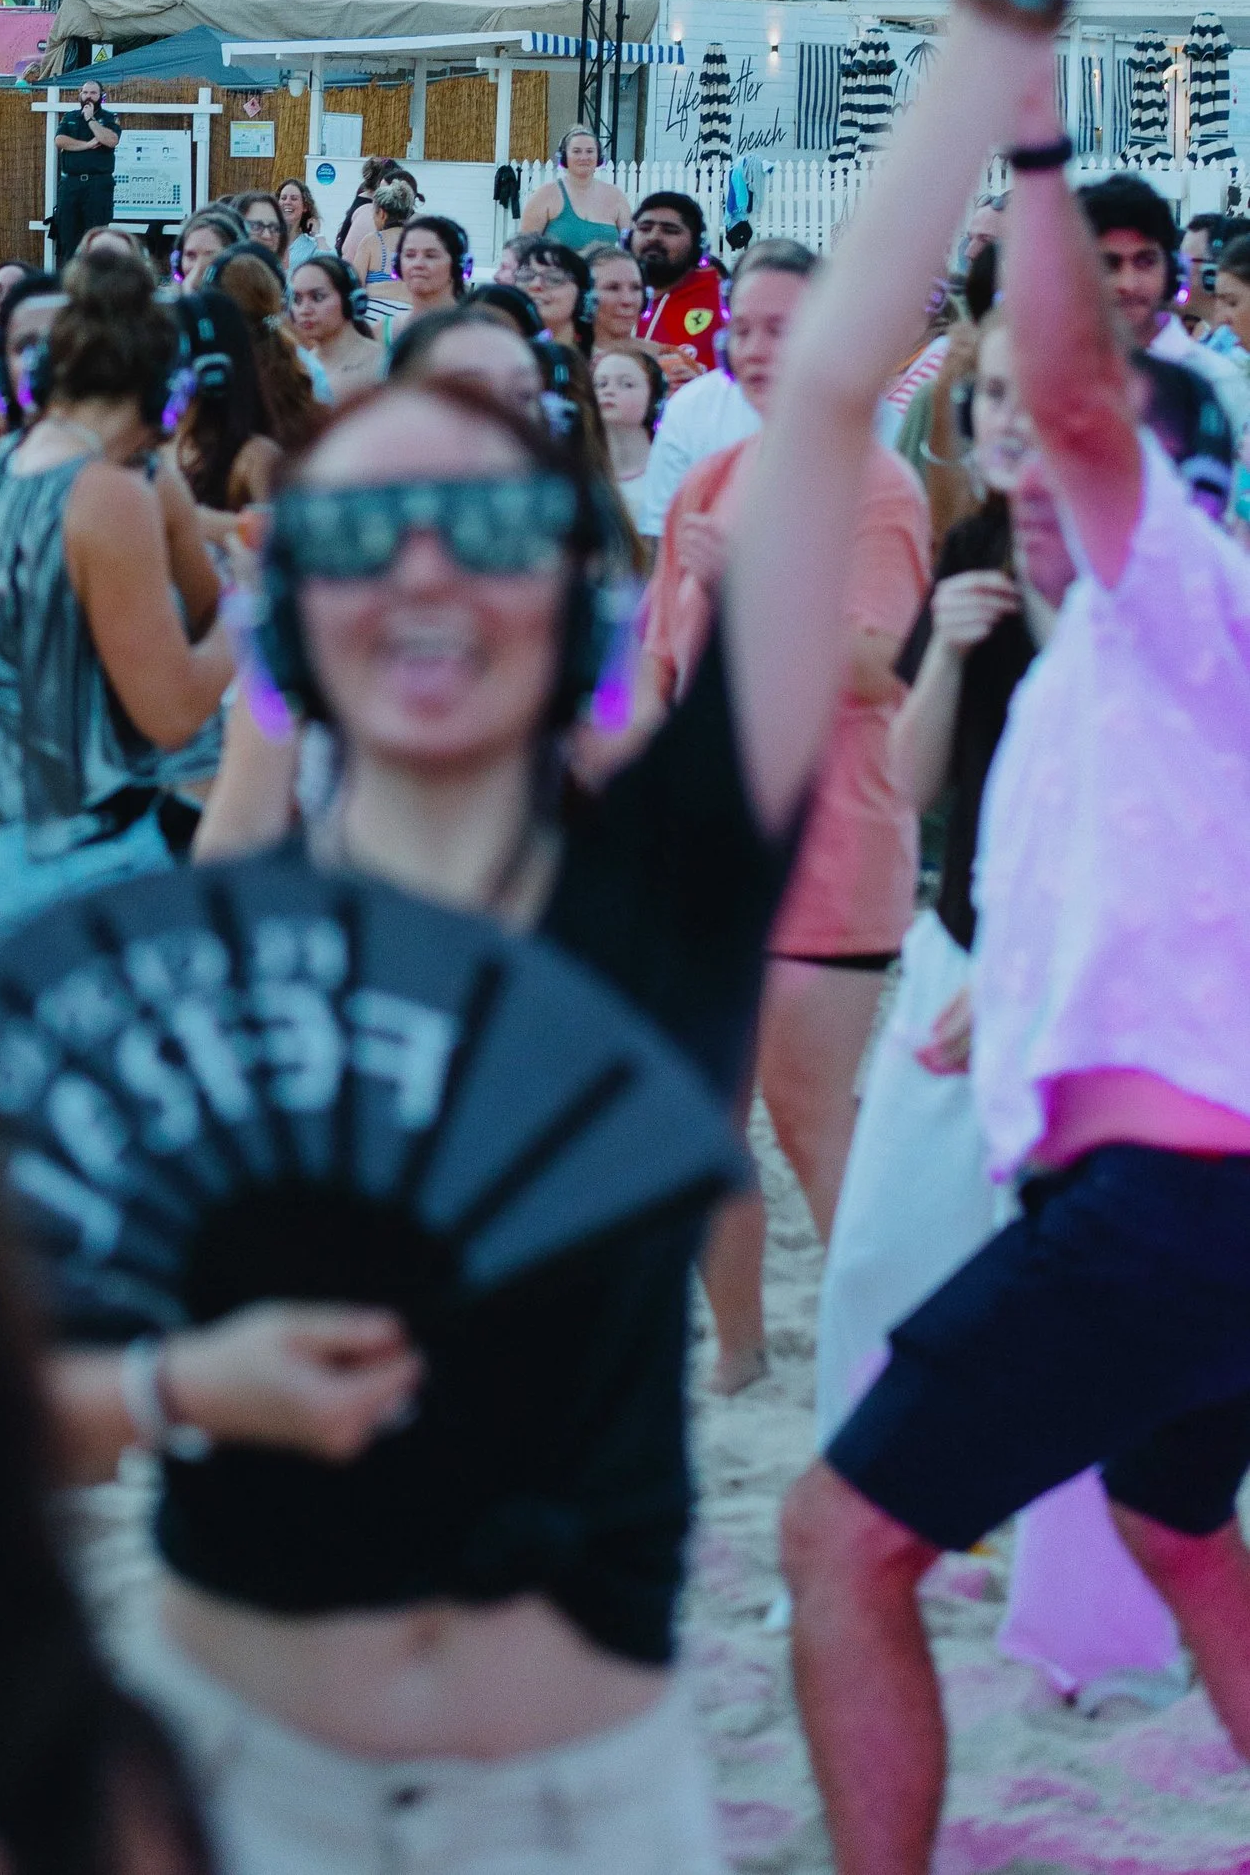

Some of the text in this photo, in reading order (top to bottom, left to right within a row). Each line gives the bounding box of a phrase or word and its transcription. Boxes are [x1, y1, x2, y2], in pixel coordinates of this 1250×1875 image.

[665, 55, 763, 142] Life etter
[737, 107, 787, 155] beach
